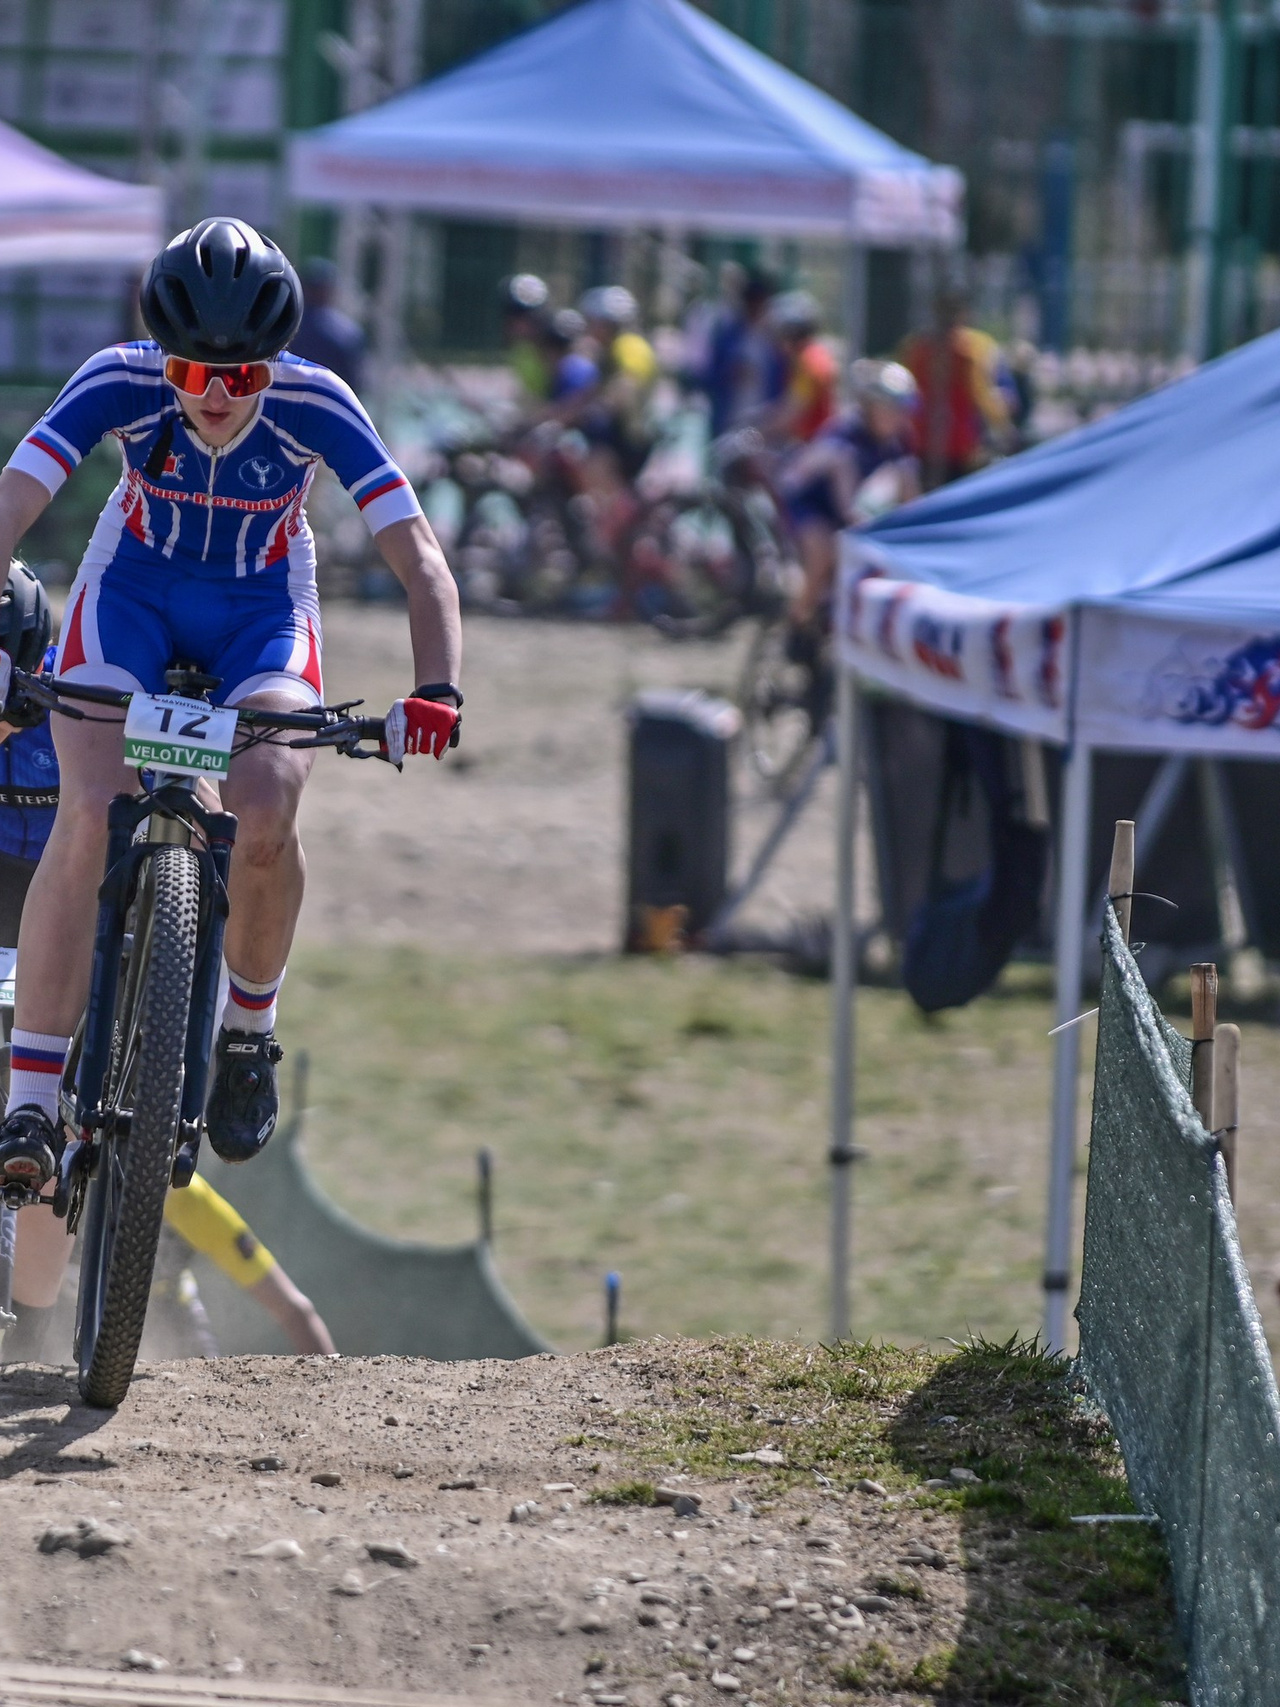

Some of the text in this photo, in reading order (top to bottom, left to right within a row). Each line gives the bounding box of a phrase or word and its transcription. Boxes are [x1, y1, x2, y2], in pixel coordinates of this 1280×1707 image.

[154, 706, 211, 740] 12
[131, 744, 223, 768] VELOTV.RU
[14, 793, 60, 805] ТЕРБ
[226, 1043, 259, 1054] SIDI
